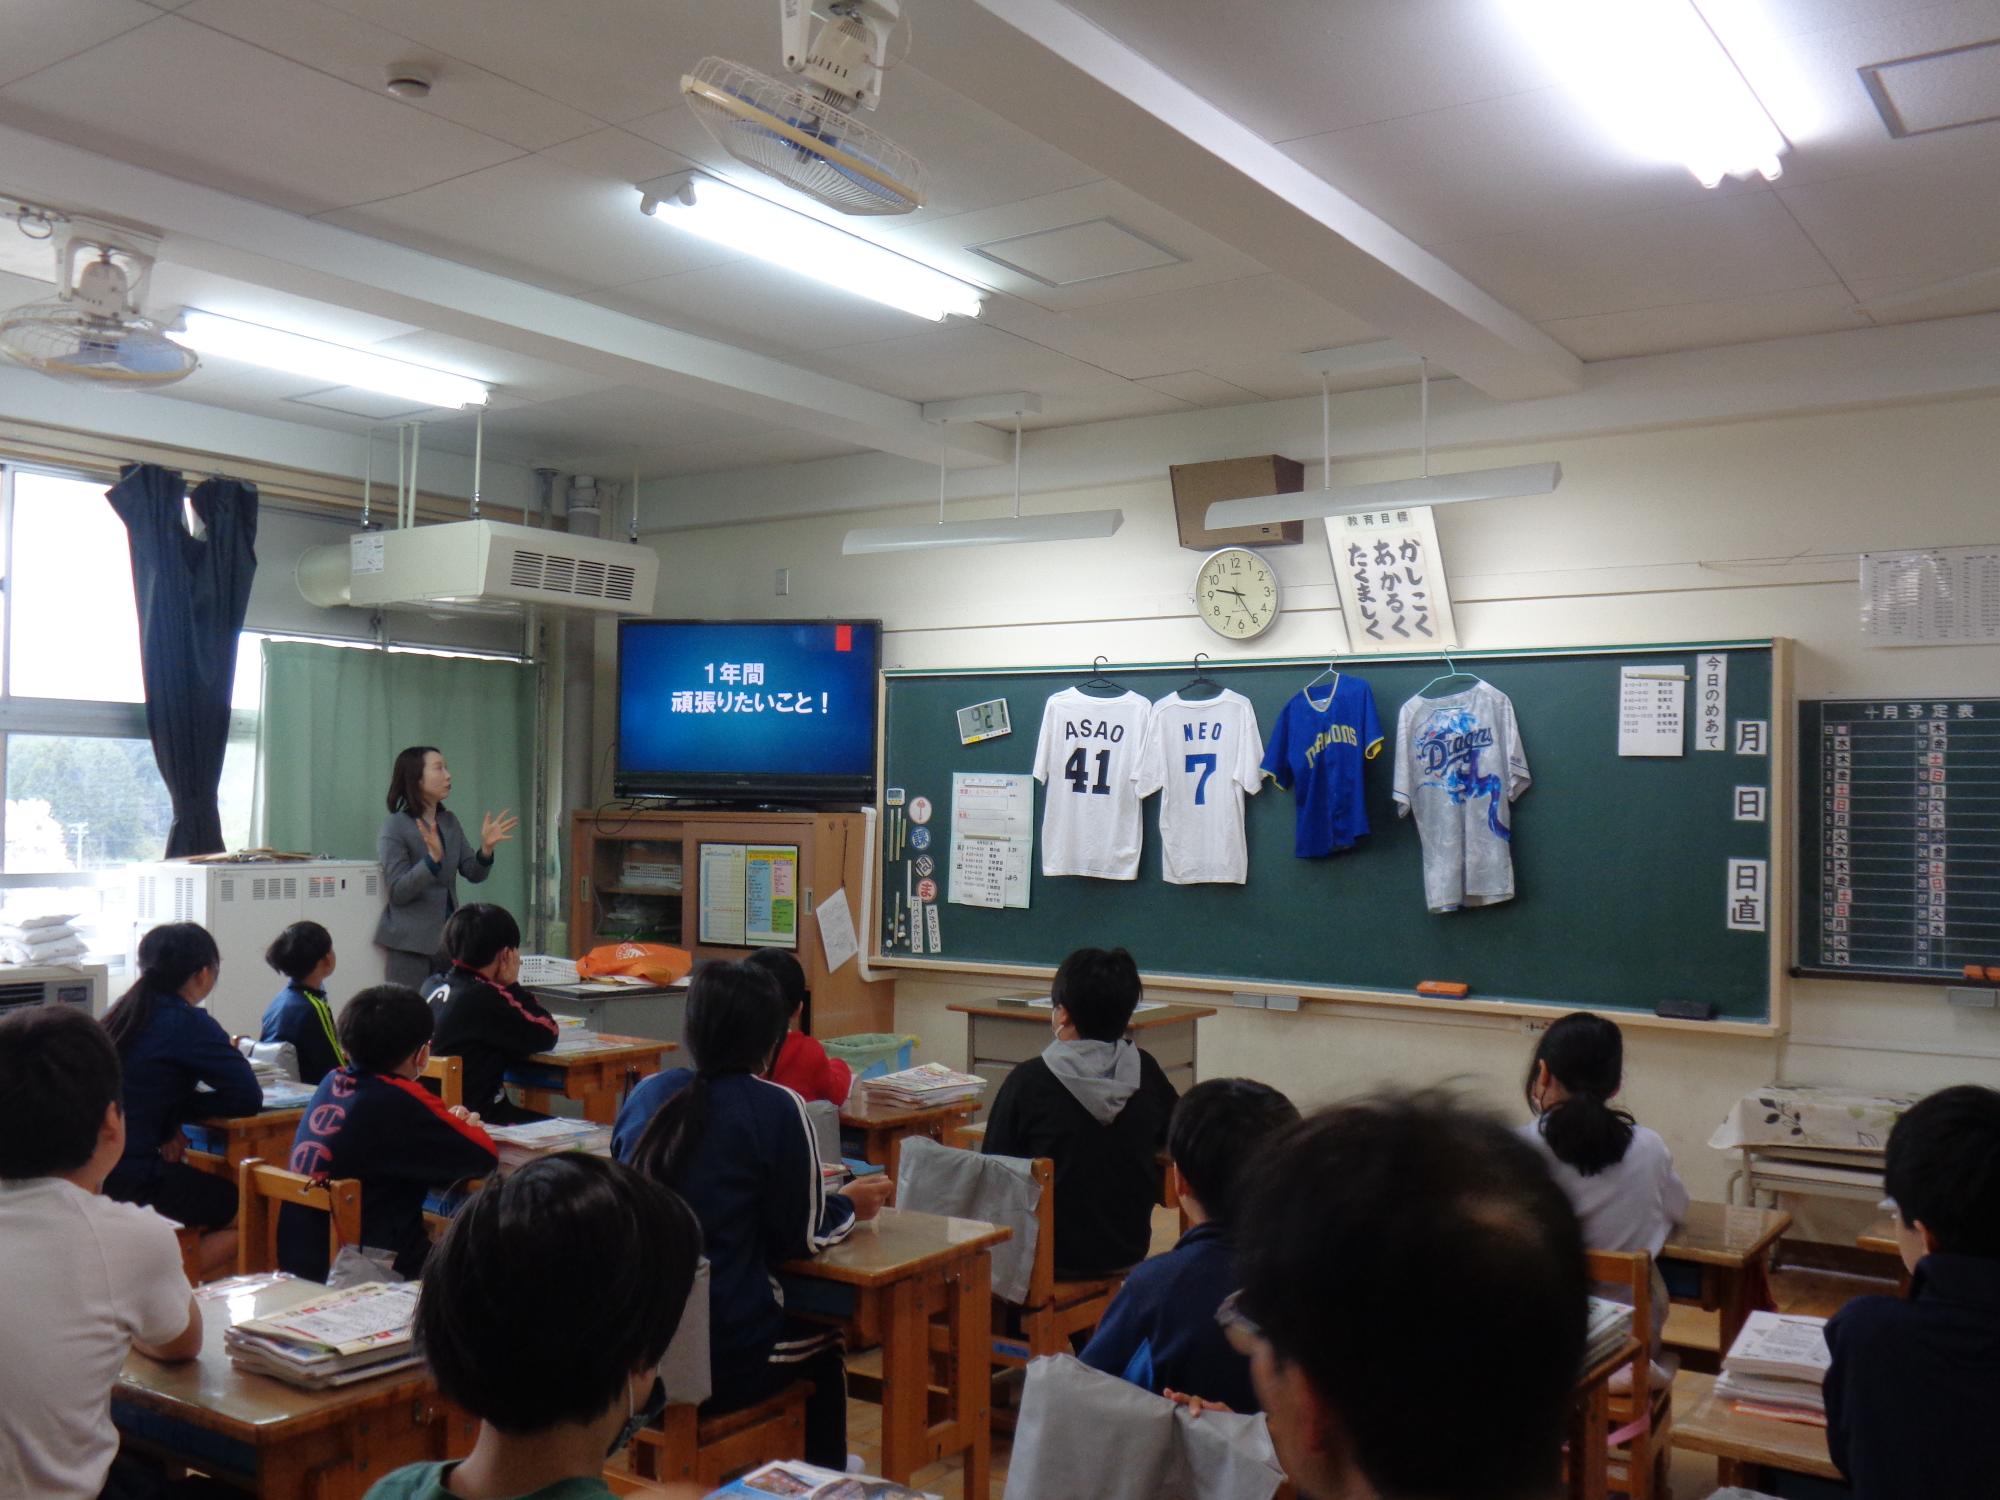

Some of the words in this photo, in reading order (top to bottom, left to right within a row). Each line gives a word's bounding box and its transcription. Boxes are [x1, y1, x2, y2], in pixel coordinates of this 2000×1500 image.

[1347, 511, 1408, 526] 教育目標
[1217, 563, 1225, 574] 11
[1230, 557, 1240, 569] 12
[1209, 574, 1219, 585] 10
[1257, 571, 1264, 581] 2
[1264, 586, 1270, 597] 3
[1348, 542, 1384, 640] たくましく
[1373, 538, 1410, 638] あかるく
[1398, 538, 1433, 638] かしこく
[1207, 590, 1214, 600] 9
[1213, 605, 1220, 616] 8
[1260, 603, 1267, 612] 4
[1225, 616, 1231, 626] 7
[1238, 620, 1244, 630] 6
[704, 663, 764, 685] 1年間
[1705, 656, 1721, 748] 今日のめあて
[1865, 704, 1974, 719] 十月予定表
[1066, 719, 1124, 743] ASAO
[1183, 722, 1222, 741] NEO
[1932, 723, 1945, 733] 木
[1739, 723, 1760, 752] 月
[1837, 739, 1848, 748] 水
[1934, 739, 1945, 749] 金
[1421, 728, 1493, 777] Dragns
[1931, 754, 1942, 765] 土
[1065, 748, 1111, 795] 41
[1933, 770, 1944, 781] 日
[1185, 754, 1217, 805] 7
[1738, 791, 1759, 816] 日
[1837, 800, 1846, 809] 日
[1931, 801, 1943, 812] 火
[1837, 815, 1847, 825] 月
[1835, 830, 1848, 842] 火
[1836, 861, 1848, 872] 木
[1931, 863, 1944, 875] 土
[1932, 879, 1943, 889] 日
[1732, 865, 1760, 925] 日直
[1837, 905, 1846, 915] 日
